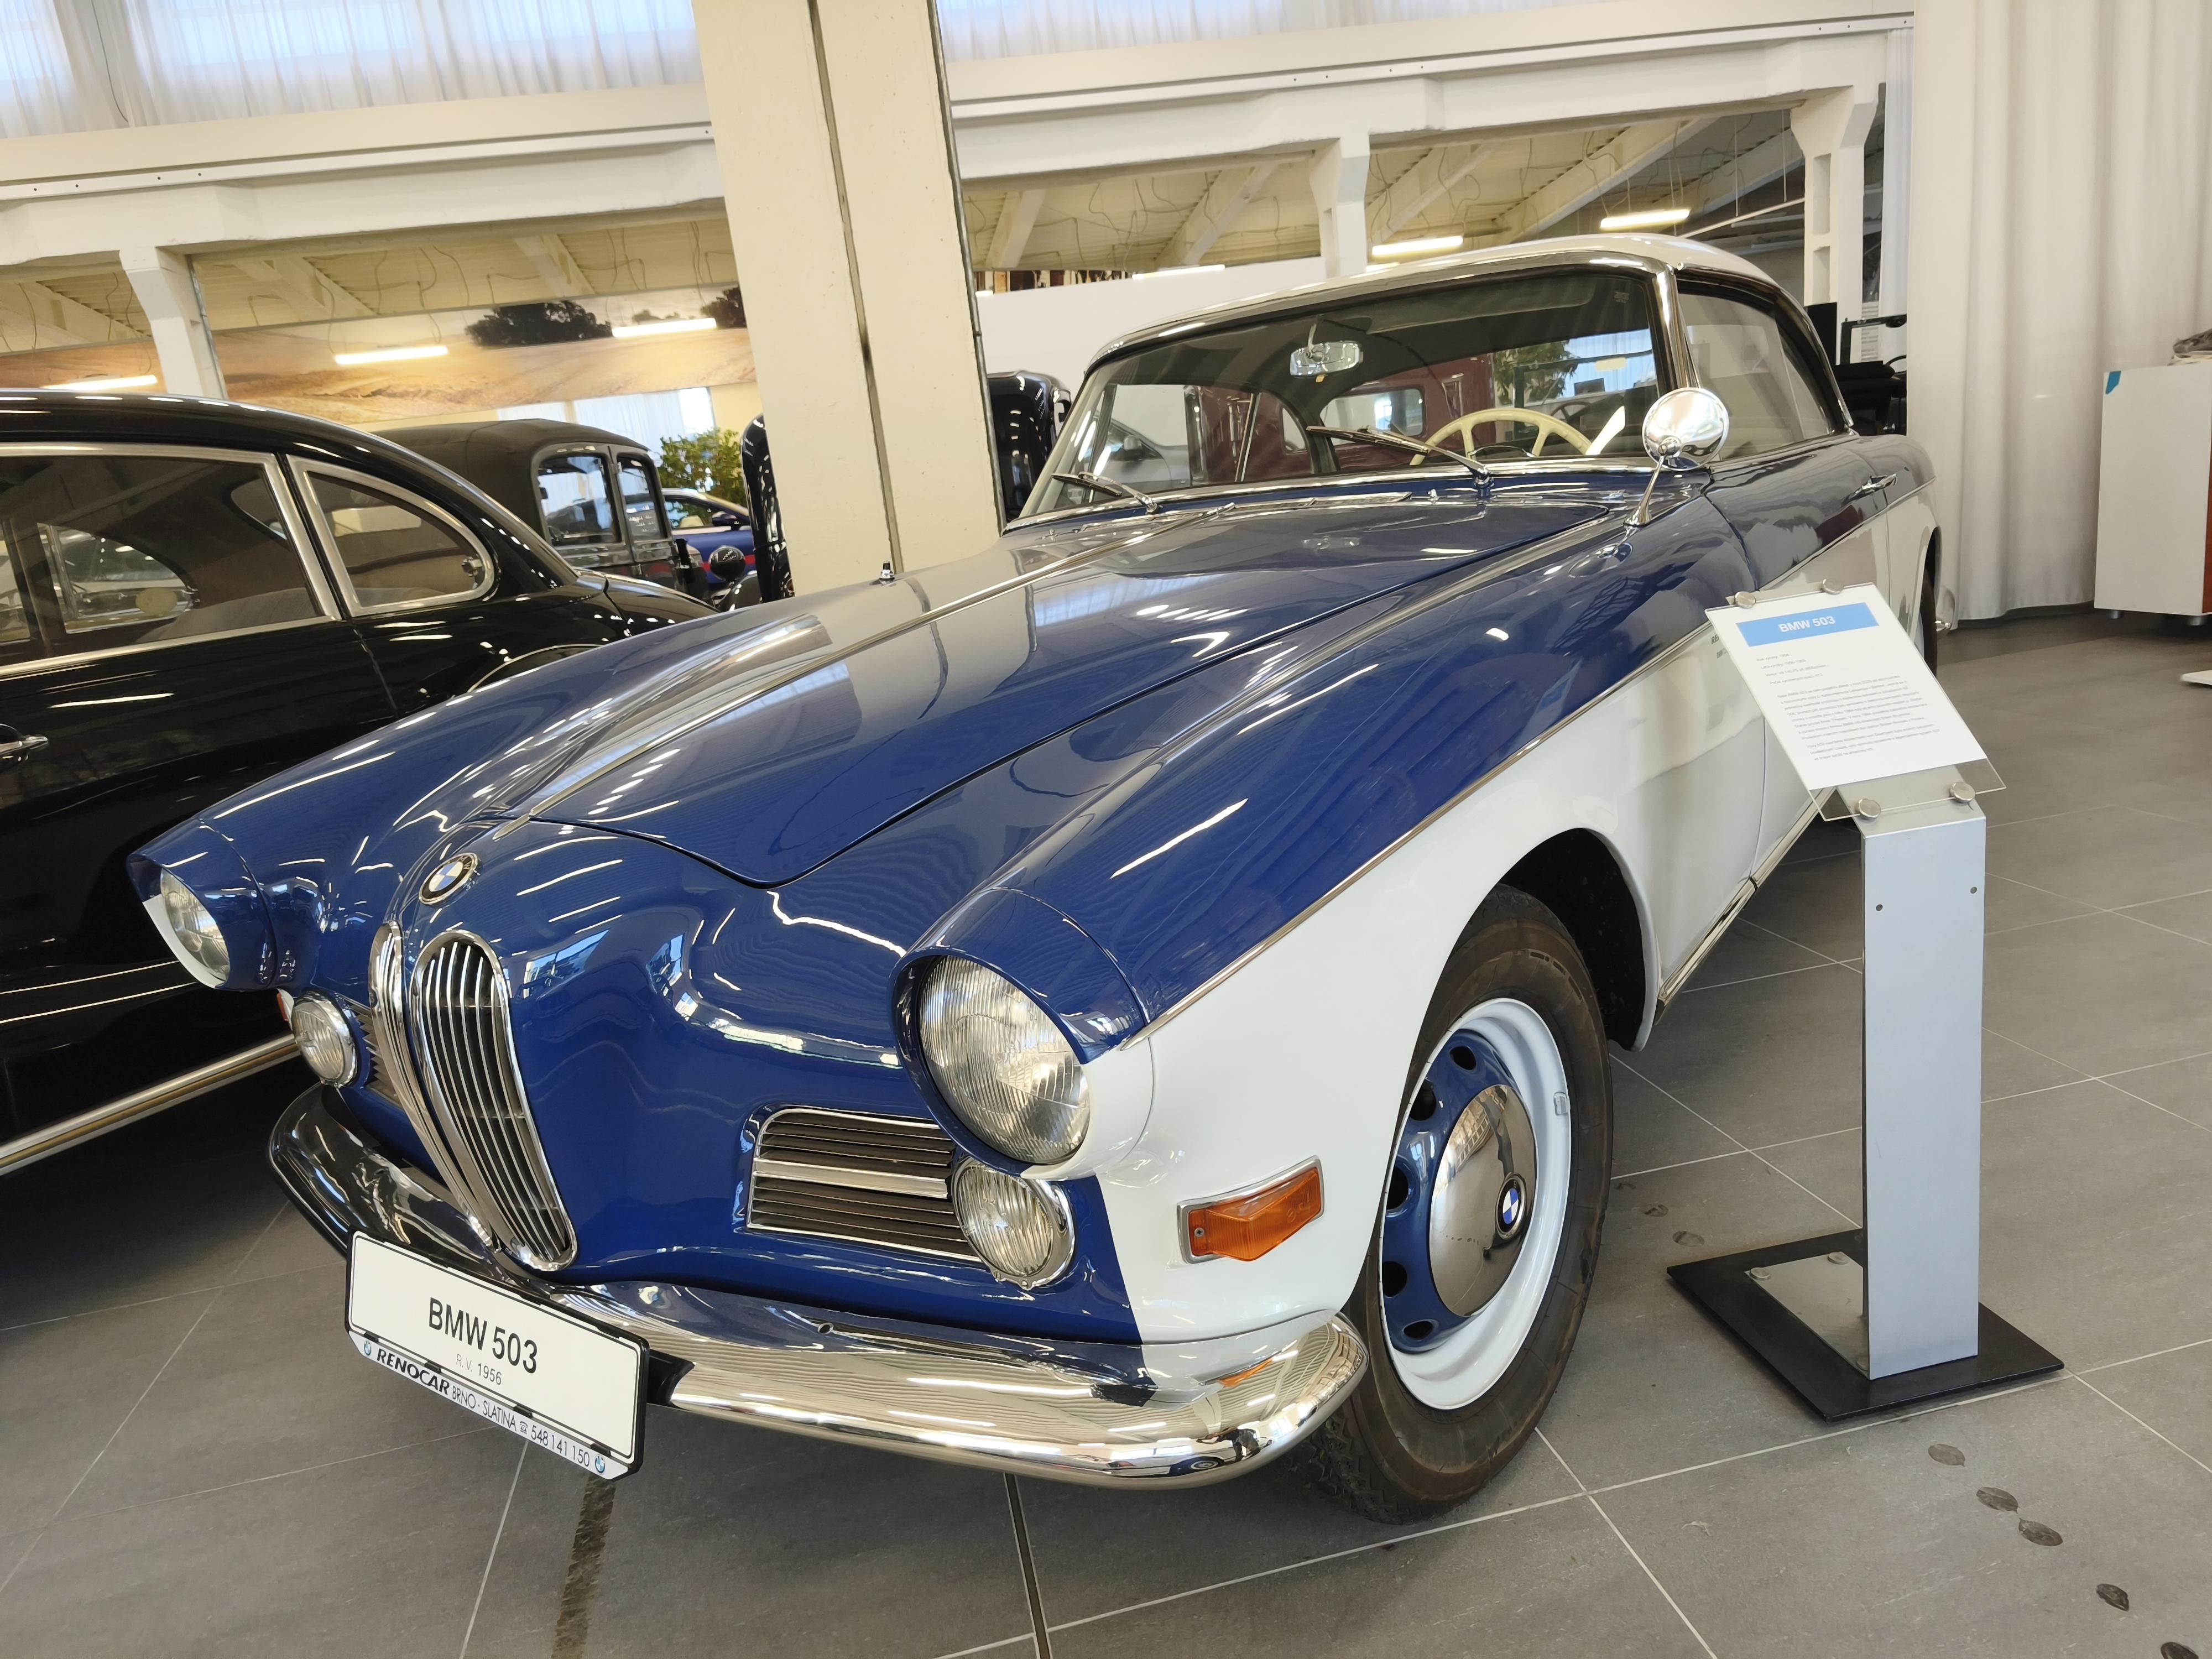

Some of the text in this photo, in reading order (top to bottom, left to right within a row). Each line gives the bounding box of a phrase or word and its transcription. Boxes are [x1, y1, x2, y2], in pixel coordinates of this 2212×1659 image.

[1778, 615, 1835, 632] BMW 503
[429, 1297, 538, 1374] BMW 503
[478, 1363, 502, 1385] 1956
[377, 1348, 450, 1395] RENOCAR
[452, 1385, 476, 1409] BRNO
[483, 1400, 517, 1431] SLATINA
[530, 1425, 548, 1446] 548
[552, 1434, 567, 1456] 141
[572, 1446, 589, 1467] 150
